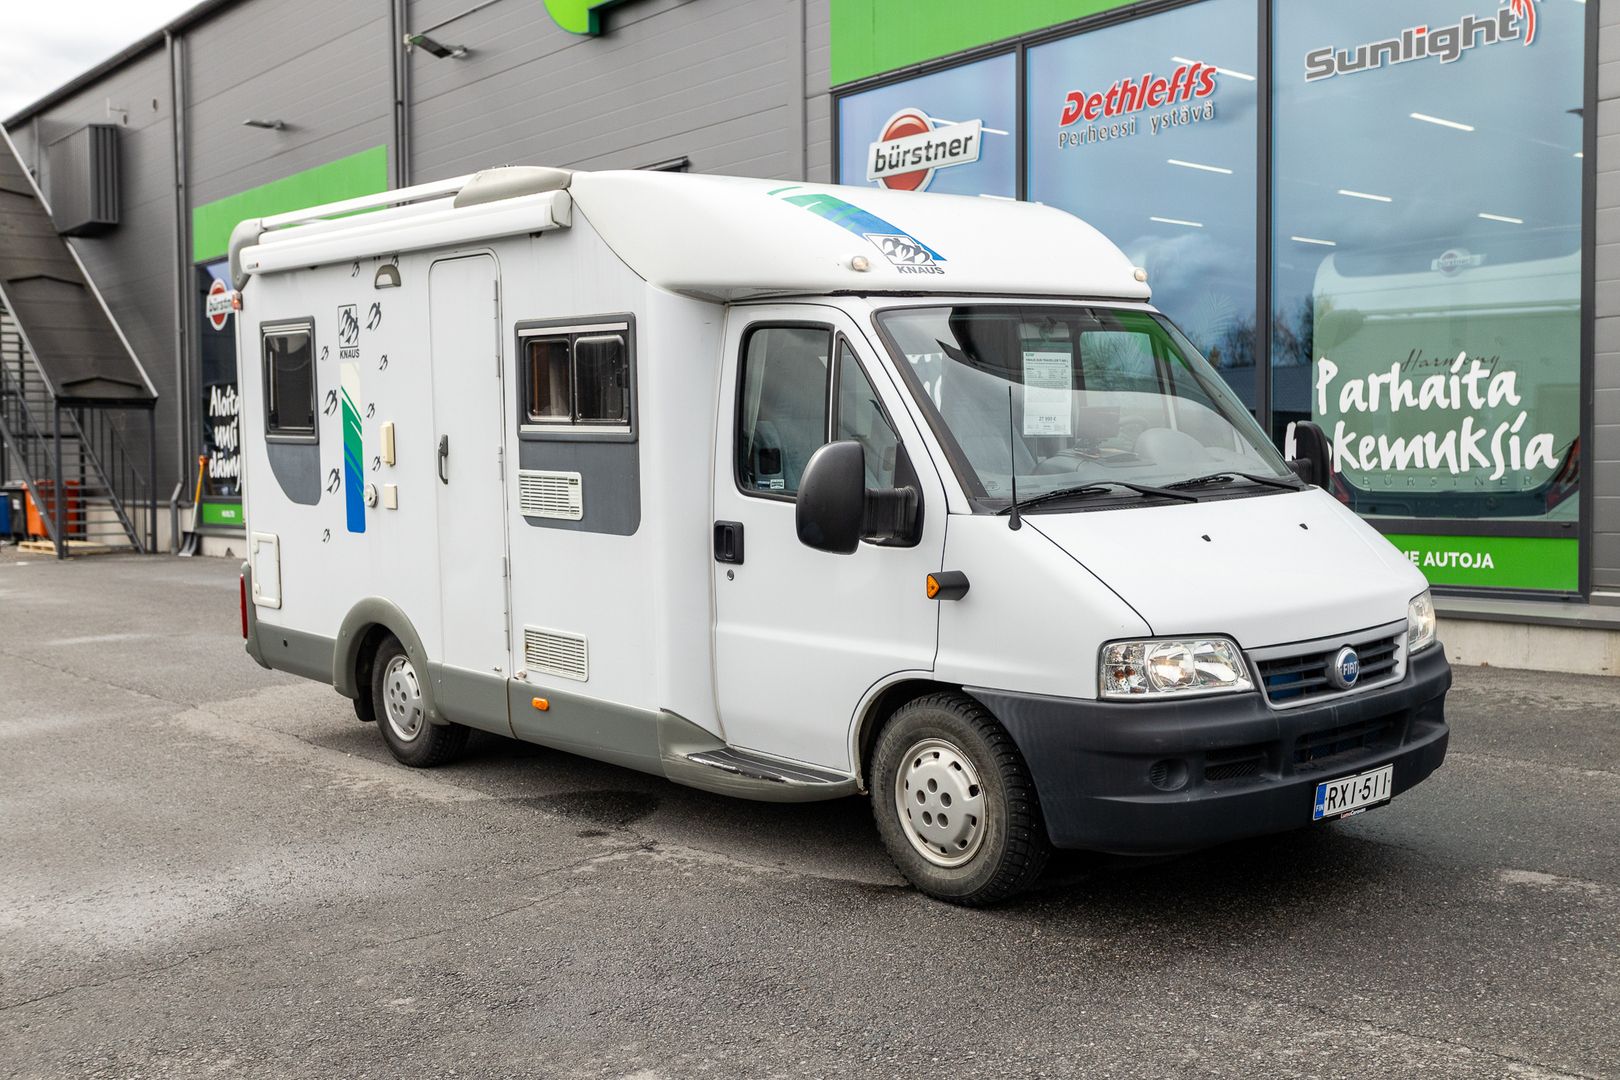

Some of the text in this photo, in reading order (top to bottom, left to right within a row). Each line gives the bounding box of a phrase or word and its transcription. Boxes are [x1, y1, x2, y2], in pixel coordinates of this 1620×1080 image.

[1305, 7, 1519, 81] Sunlight
[1059, 62, 1217, 127] Dethleffs
[1058, 102, 1215, 149] Perheesi ystävä
[873, 133, 974, 174] bürstner
[897, 265, 945, 275] KNAUS
[339, 348, 360, 360] KNAUS
[1423, 551, 1495, 570] AUTOJA
[1343, 661, 1358, 676] FIAT
[1327, 771, 1388, 811] RXI-511
[1315, 803, 1324, 814] FIN
